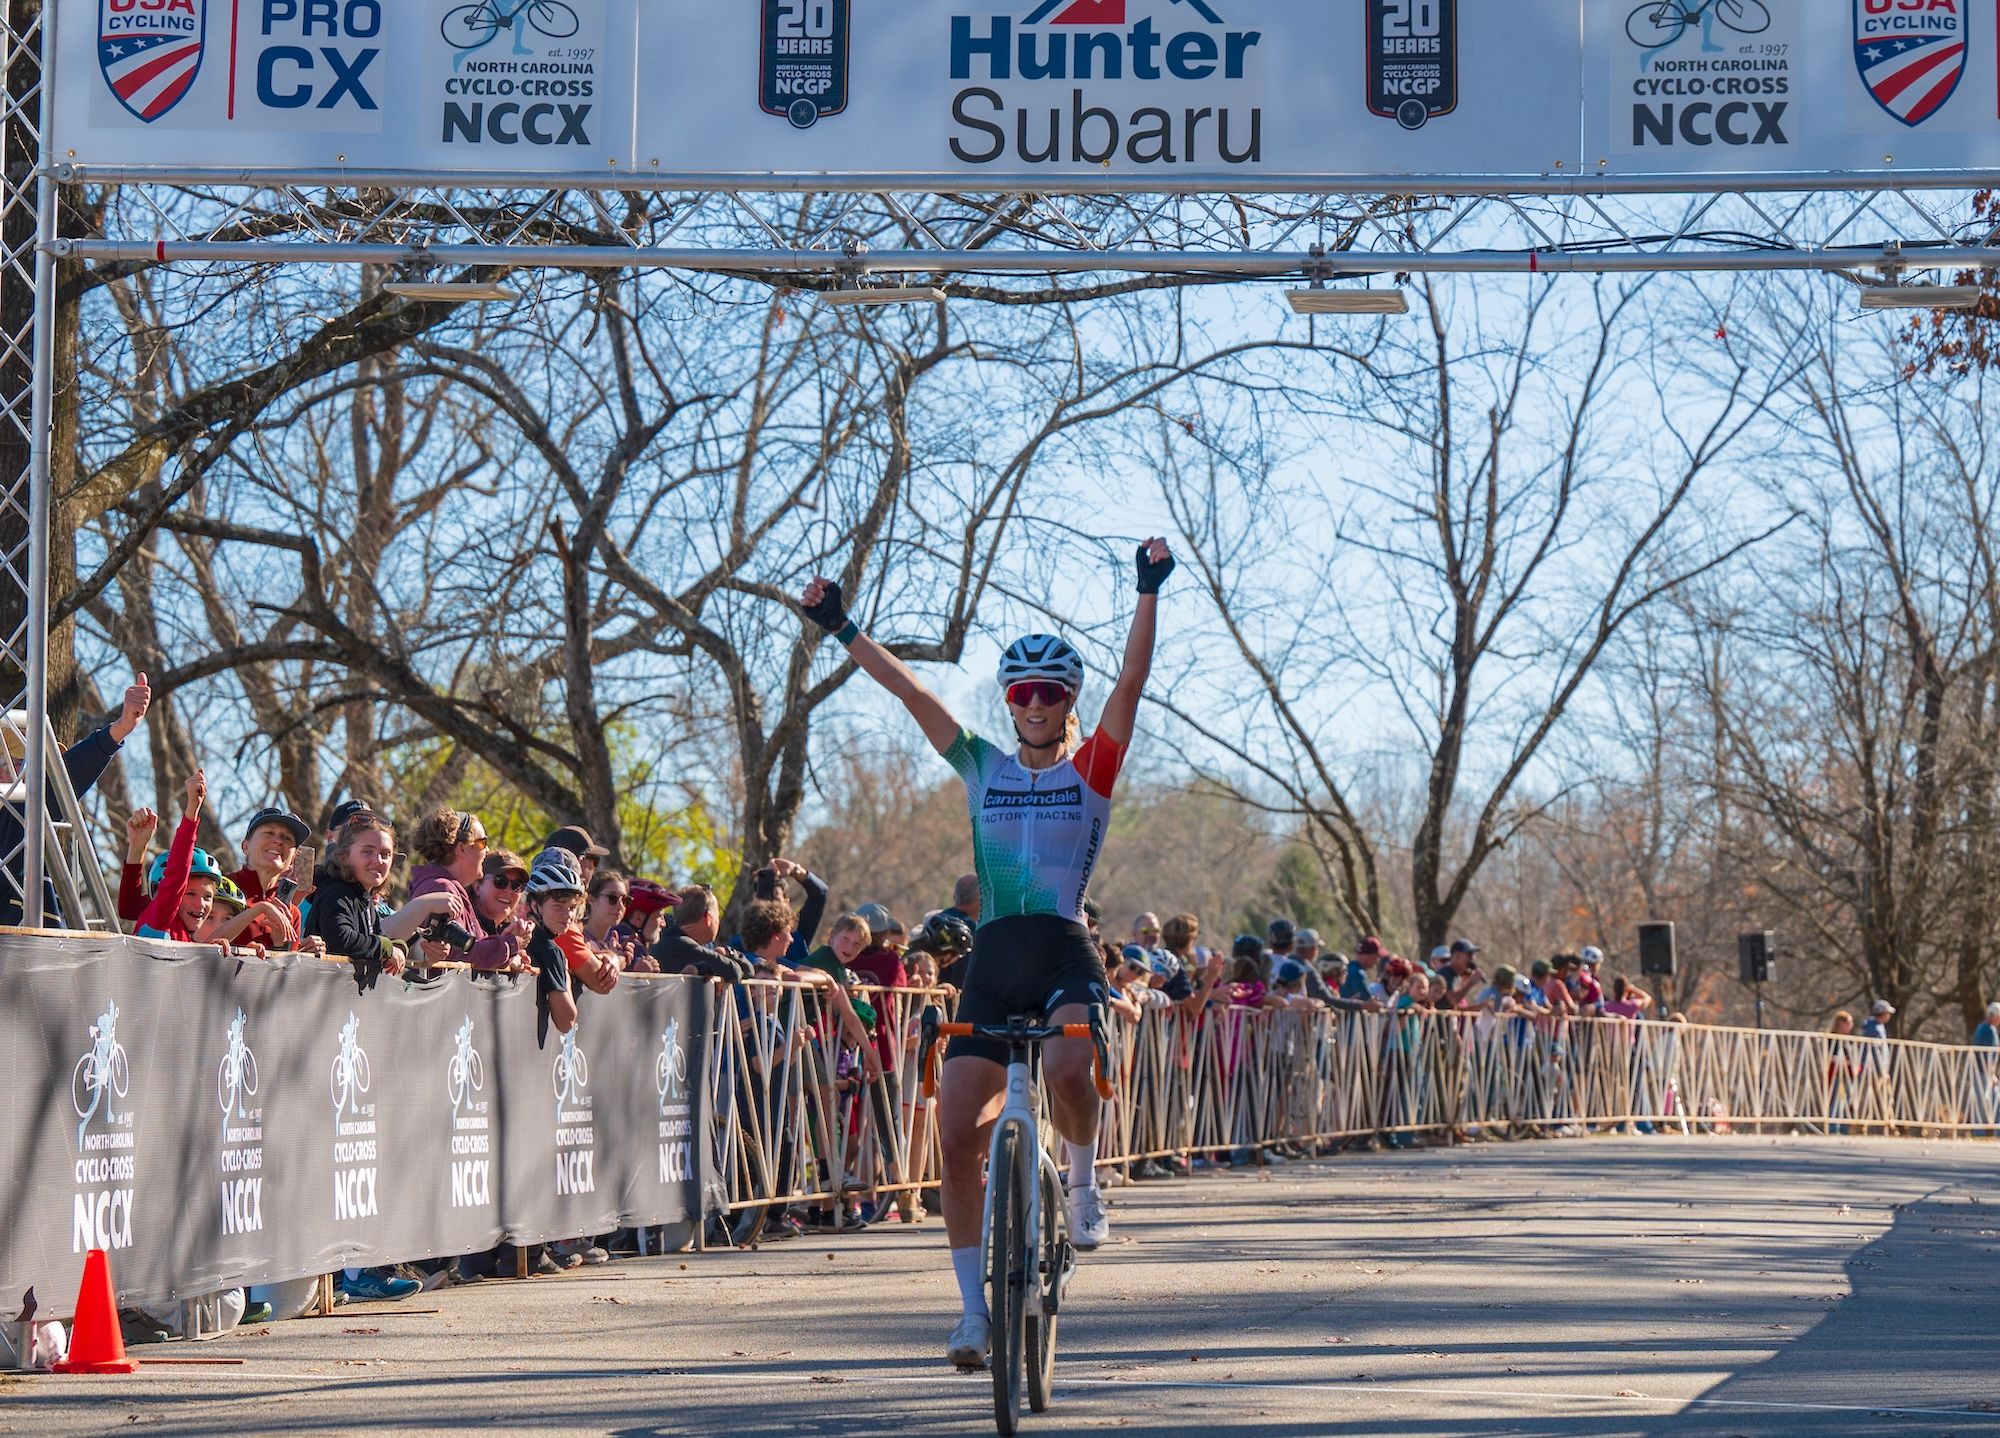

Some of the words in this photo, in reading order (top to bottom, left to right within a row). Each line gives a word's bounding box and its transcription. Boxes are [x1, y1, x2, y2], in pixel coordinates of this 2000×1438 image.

[109, 15, 195, 31] CYCLING
[261, 0, 381, 37] PRO
[777, 0, 833, 38] 20
[1383, 0, 1440, 37] 20
[1865, 15, 1957, 32] CYCLING
[548, 48, 563, 57] est.
[567, 48, 595, 60] 1997
[776, 39, 833, 54] YEARS
[950, 16, 1262, 80] Hunter
[1383, 38, 1440, 54] YEARS
[1739, 44, 1755, 54] est.
[1759, 44, 1788, 56] 1997
[466, 62, 517, 73] NORTH
[521, 62, 594, 74] CAROLINA
[776, 70, 832, 78] CYCLO-CROSS
[1383, 70, 1440, 78] CYCLO-CROSS
[1654, 60, 1707, 72] NORTH
[1711, 59, 1788, 71] CAROLINA
[257, 45, 381, 110] CX
[775, 78, 833, 95] NCGP
[1383, 78, 1441, 95] NCGP
[442, 101, 593, 145] NCCX
[949, 87, 1261, 164] Subaru
[1633, 102, 1789, 146] NCCX
[985, 790, 1078, 806] cannondale
[981, 811, 1029, 823] FACTORY
[1036, 811, 1082, 821] RACING
[85, 1133, 109, 1150] NORTH
[110, 1131, 134, 1149] CAROLINA
[659, 1141, 693, 1184] NCCX
[556, 1150, 595, 1195] NCCX
[451, 1159, 490, 1207] NCCX
[334, 1167, 378, 1221] NCCX
[221, 1177, 263, 1236] NCCX
[73, 1189, 134, 1253] NCCX
